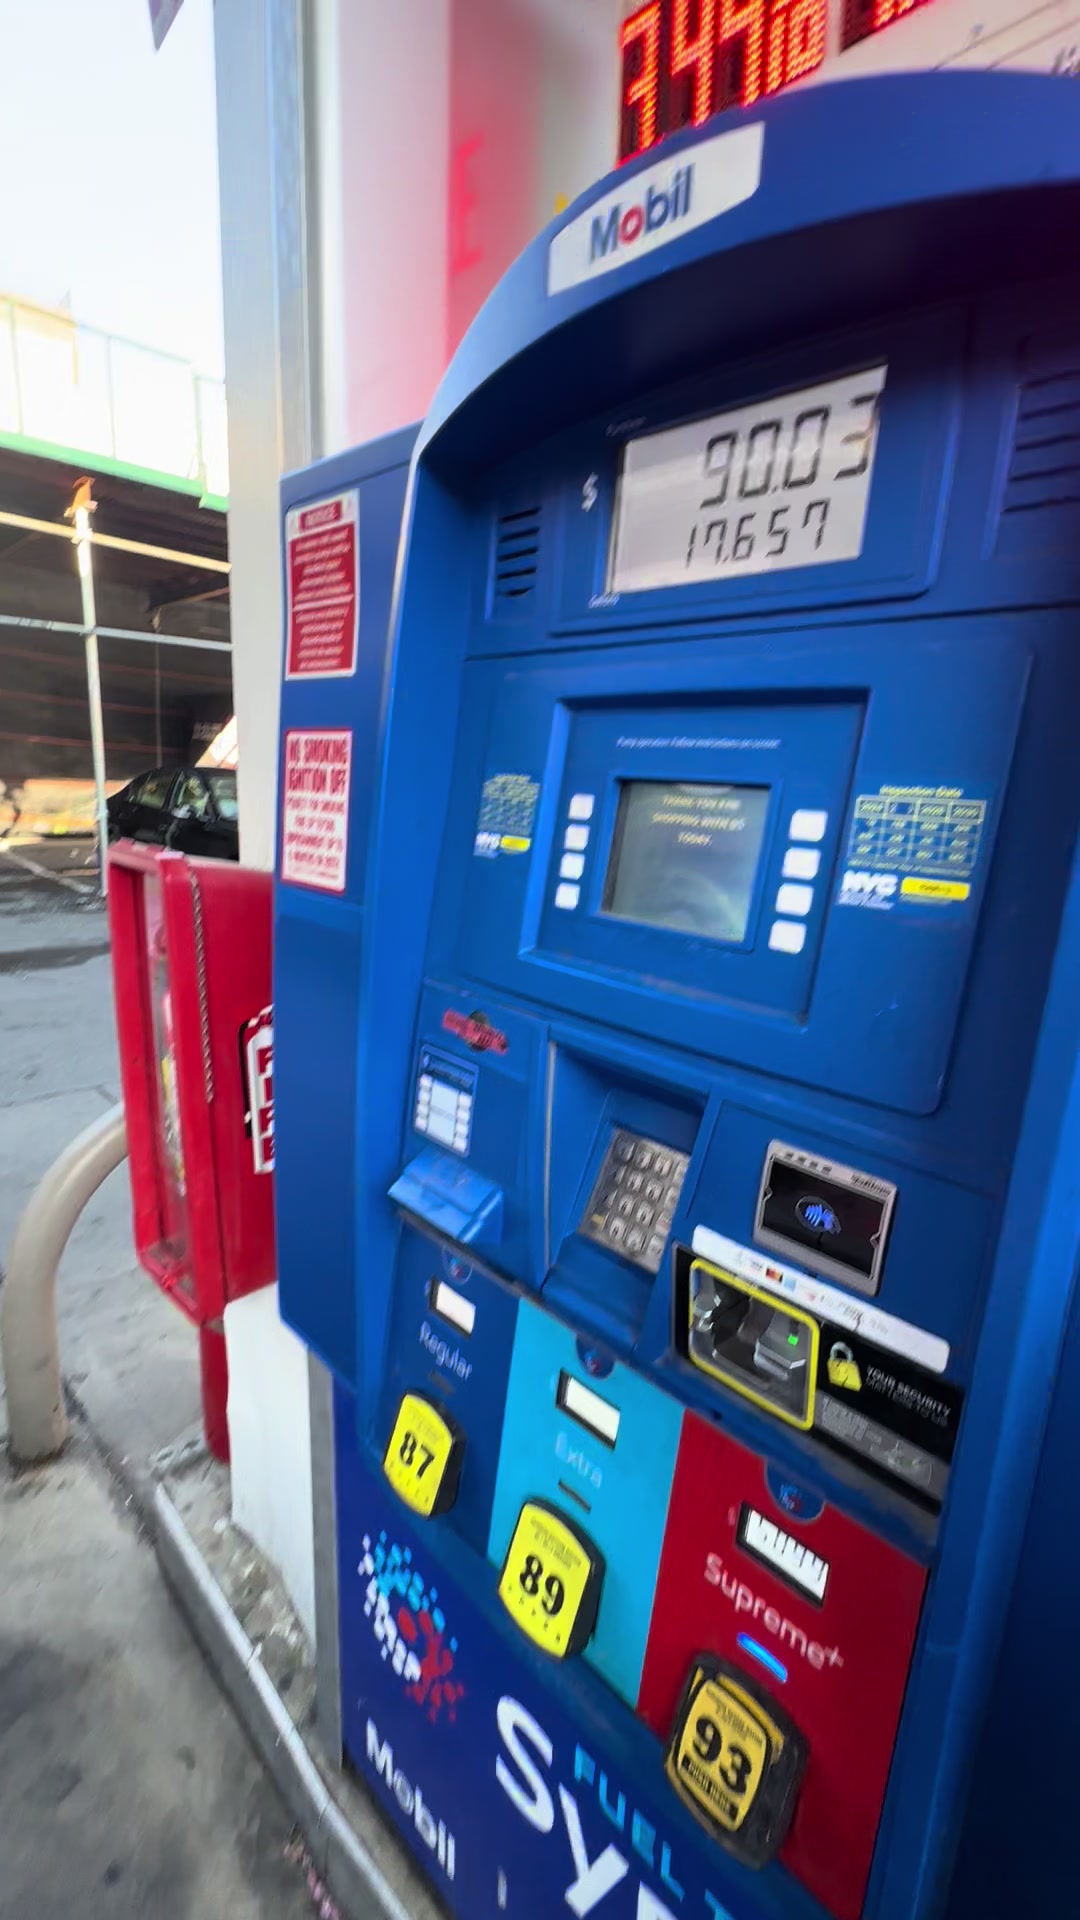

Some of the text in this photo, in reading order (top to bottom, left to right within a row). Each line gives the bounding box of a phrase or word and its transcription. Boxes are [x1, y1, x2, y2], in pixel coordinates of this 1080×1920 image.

[588, 163, 696, 265] Mobil
[685, 498, 832, 569] 17.657
[419, 1320, 474, 1381] Regular
[400, 1431, 435, 1481] 87
[554, 1432, 604, 1489] Extra
[520, 1554, 565, 1617] 89
[704, 1551, 845, 1671] Supreme+
[692, 1714, 753, 1795] 93
[366, 1716, 456, 1881] Mobil
[574, 1742, 686, 1904] FUEL
